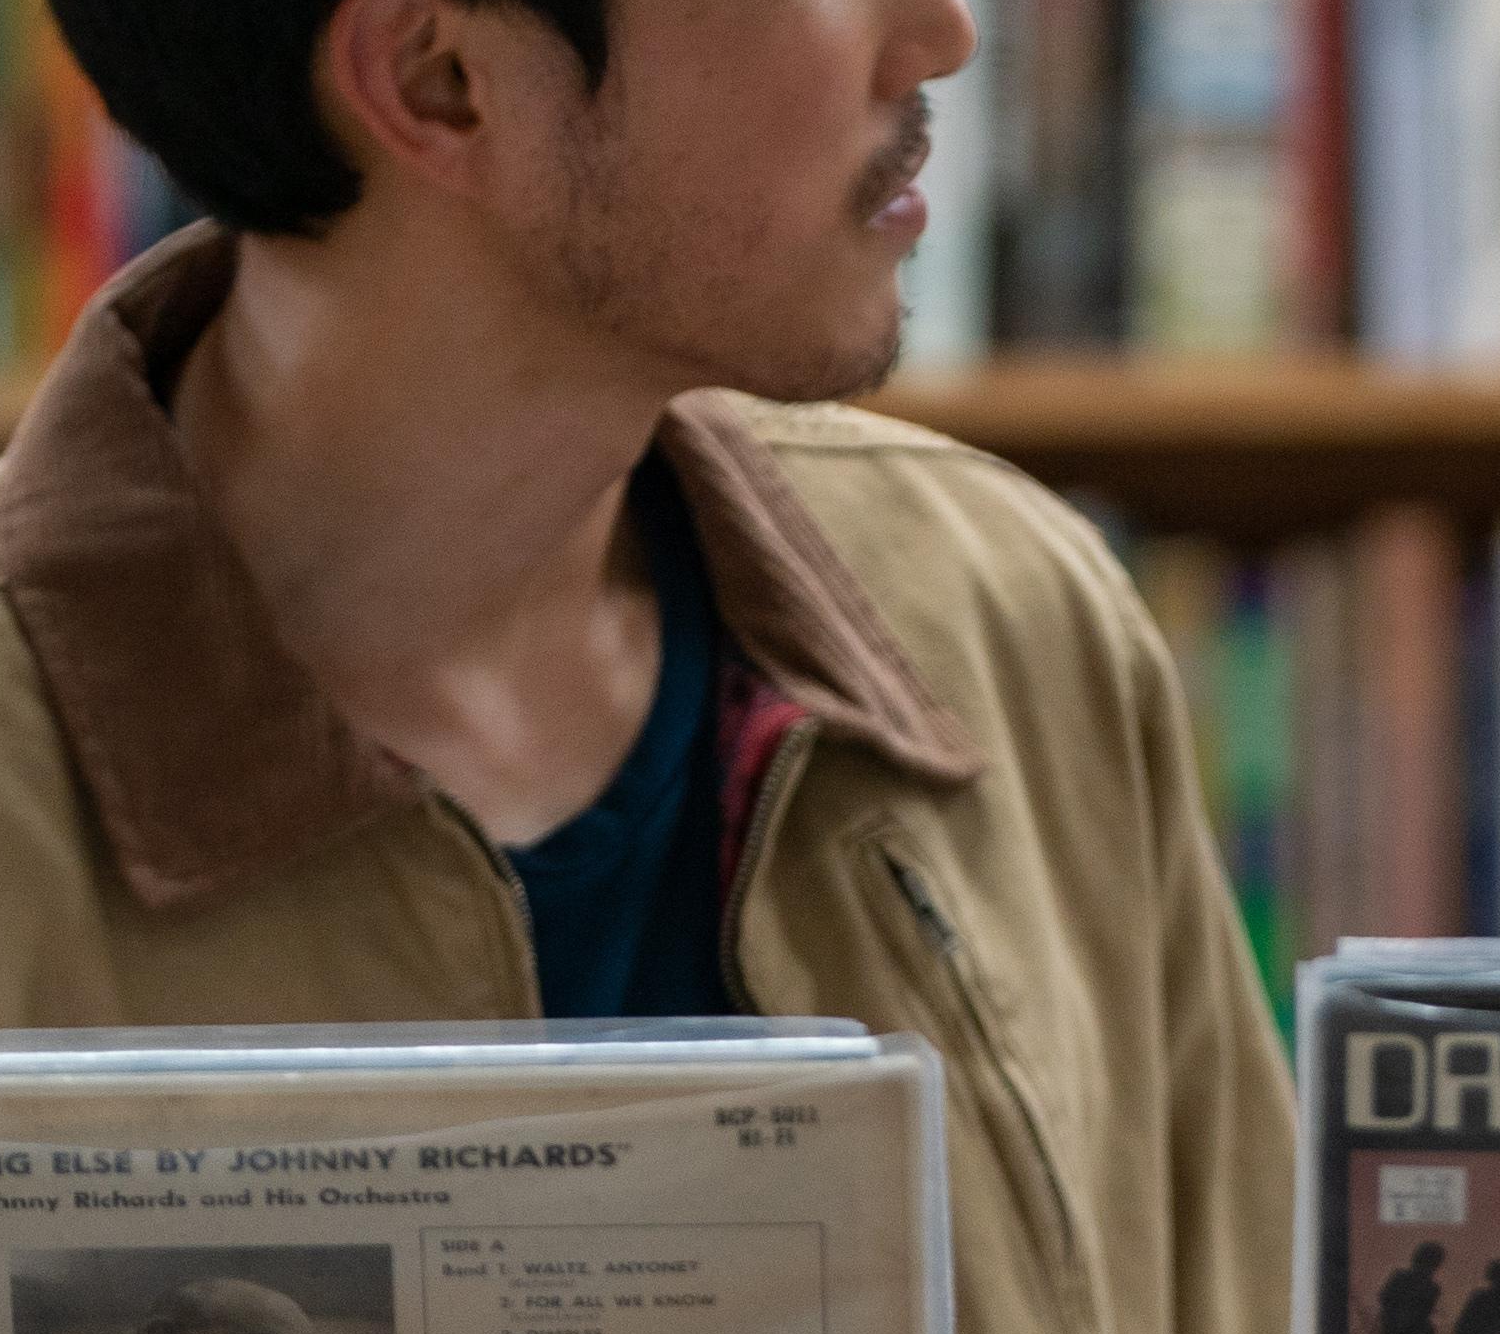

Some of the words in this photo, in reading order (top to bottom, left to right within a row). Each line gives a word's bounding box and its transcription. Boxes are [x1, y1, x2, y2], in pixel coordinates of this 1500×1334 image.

[51, 1151, 133, 1174] ELSE
[156, 1150, 207, 1174] BY
[228, 1145, 397, 1173] JOHNNY
[74, 1189, 187, 1209] Richards
[200, 1188, 251, 1207] and
[265, 1188, 306, 1206] His
[318, 1186, 451, 1205] Orchestra
[440, 1240, 480, 1253] SIDE
[489, 1239, 505, 1252] A
[525, 1295, 562, 1308] FOR
[572, 1294, 604, 1308] ALL
[613, 1294, 643, 1307] WE
[652, 1293, 717, 1307] KNOW
